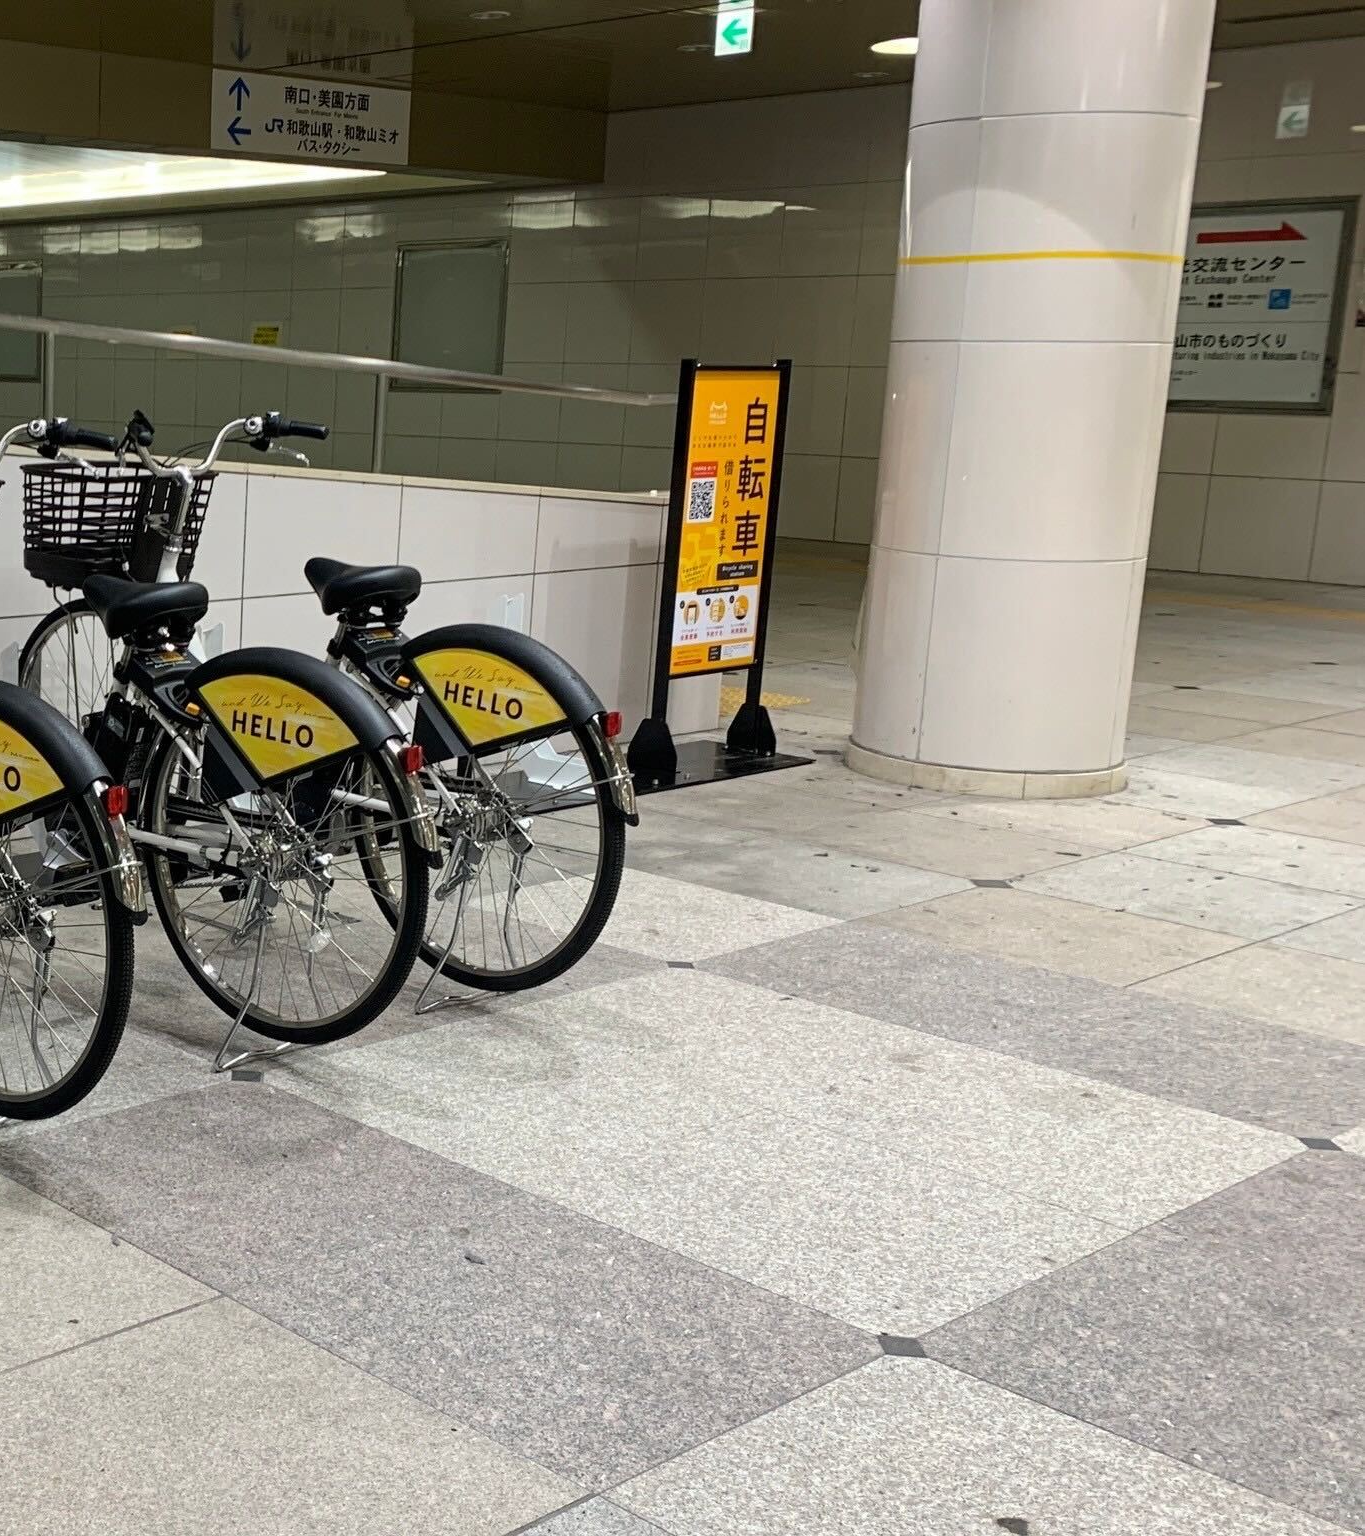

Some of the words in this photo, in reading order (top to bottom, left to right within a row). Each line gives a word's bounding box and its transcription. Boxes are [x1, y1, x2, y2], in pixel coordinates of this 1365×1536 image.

[285, 86, 370, 112] 南口・美園方面
[297, 138, 361, 156] バス・タクシー
[1195, 275, 1238, 285] Exchange
[1243, 274, 1276, 284] Center
[732, 396, 768, 556] 自転車
[444, 680, 523, 720] HELLO
[232, 710, 315, 748] HELLO
